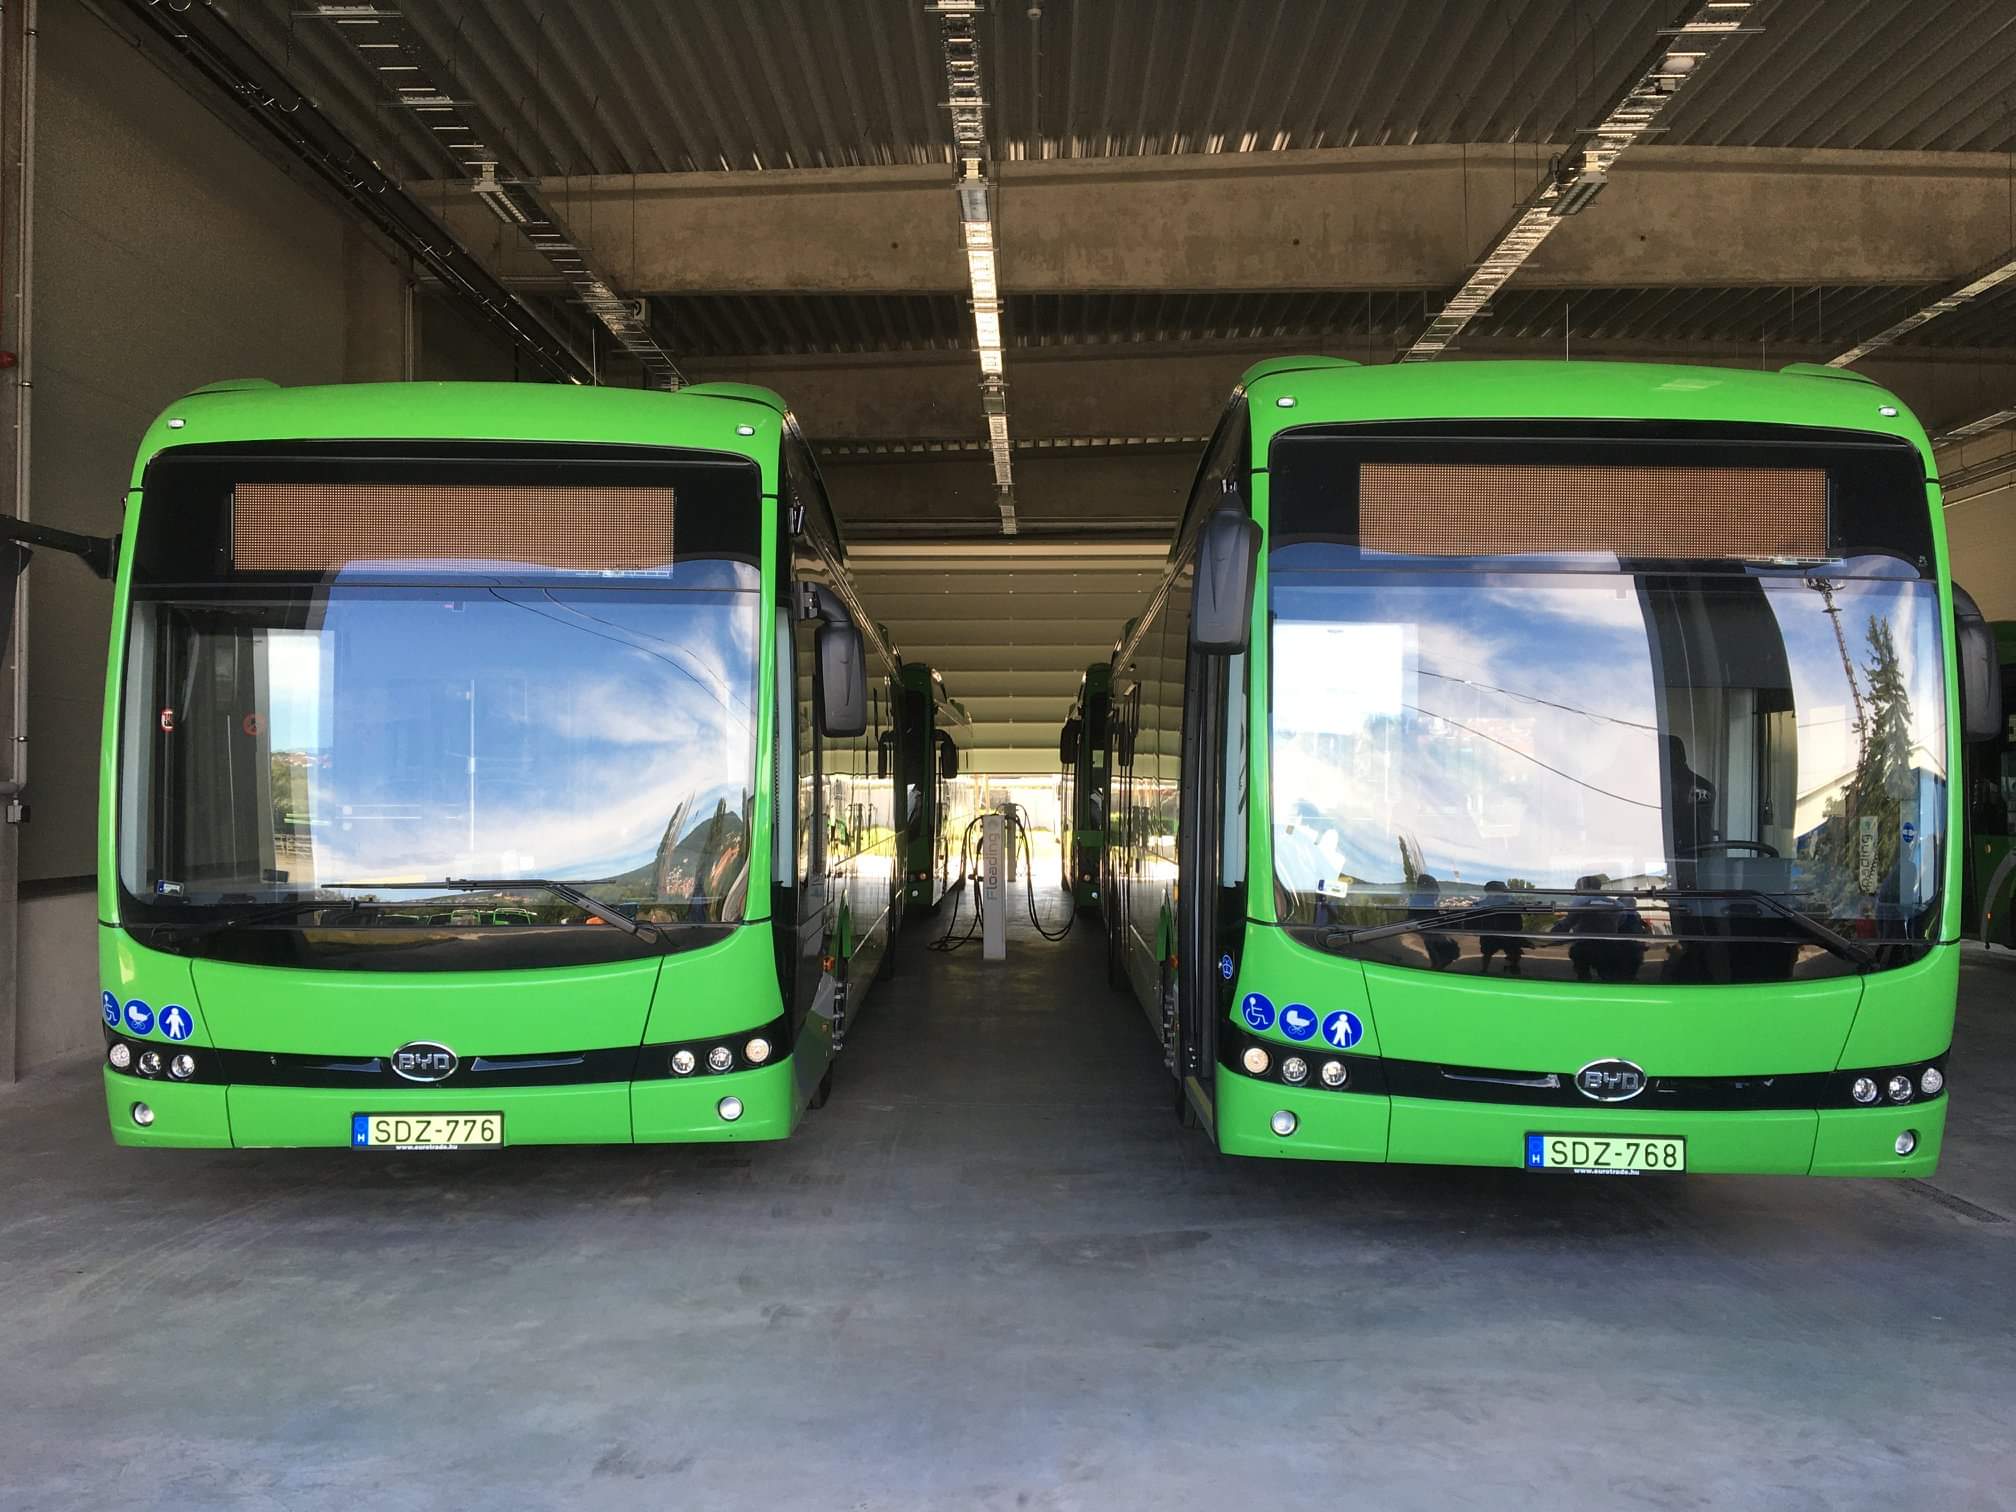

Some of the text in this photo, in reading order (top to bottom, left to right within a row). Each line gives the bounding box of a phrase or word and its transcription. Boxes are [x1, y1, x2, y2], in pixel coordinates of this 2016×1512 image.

[398, 1053, 450, 1070] BYD
[1584, 1071, 1639, 1089] BYD
[357, 1119, 495, 1143] H SDZ-776
[1532, 1140, 1677, 1168] H SDZ-768
[1573, 1167, 1640, 1176] www.eurotrade.hu
